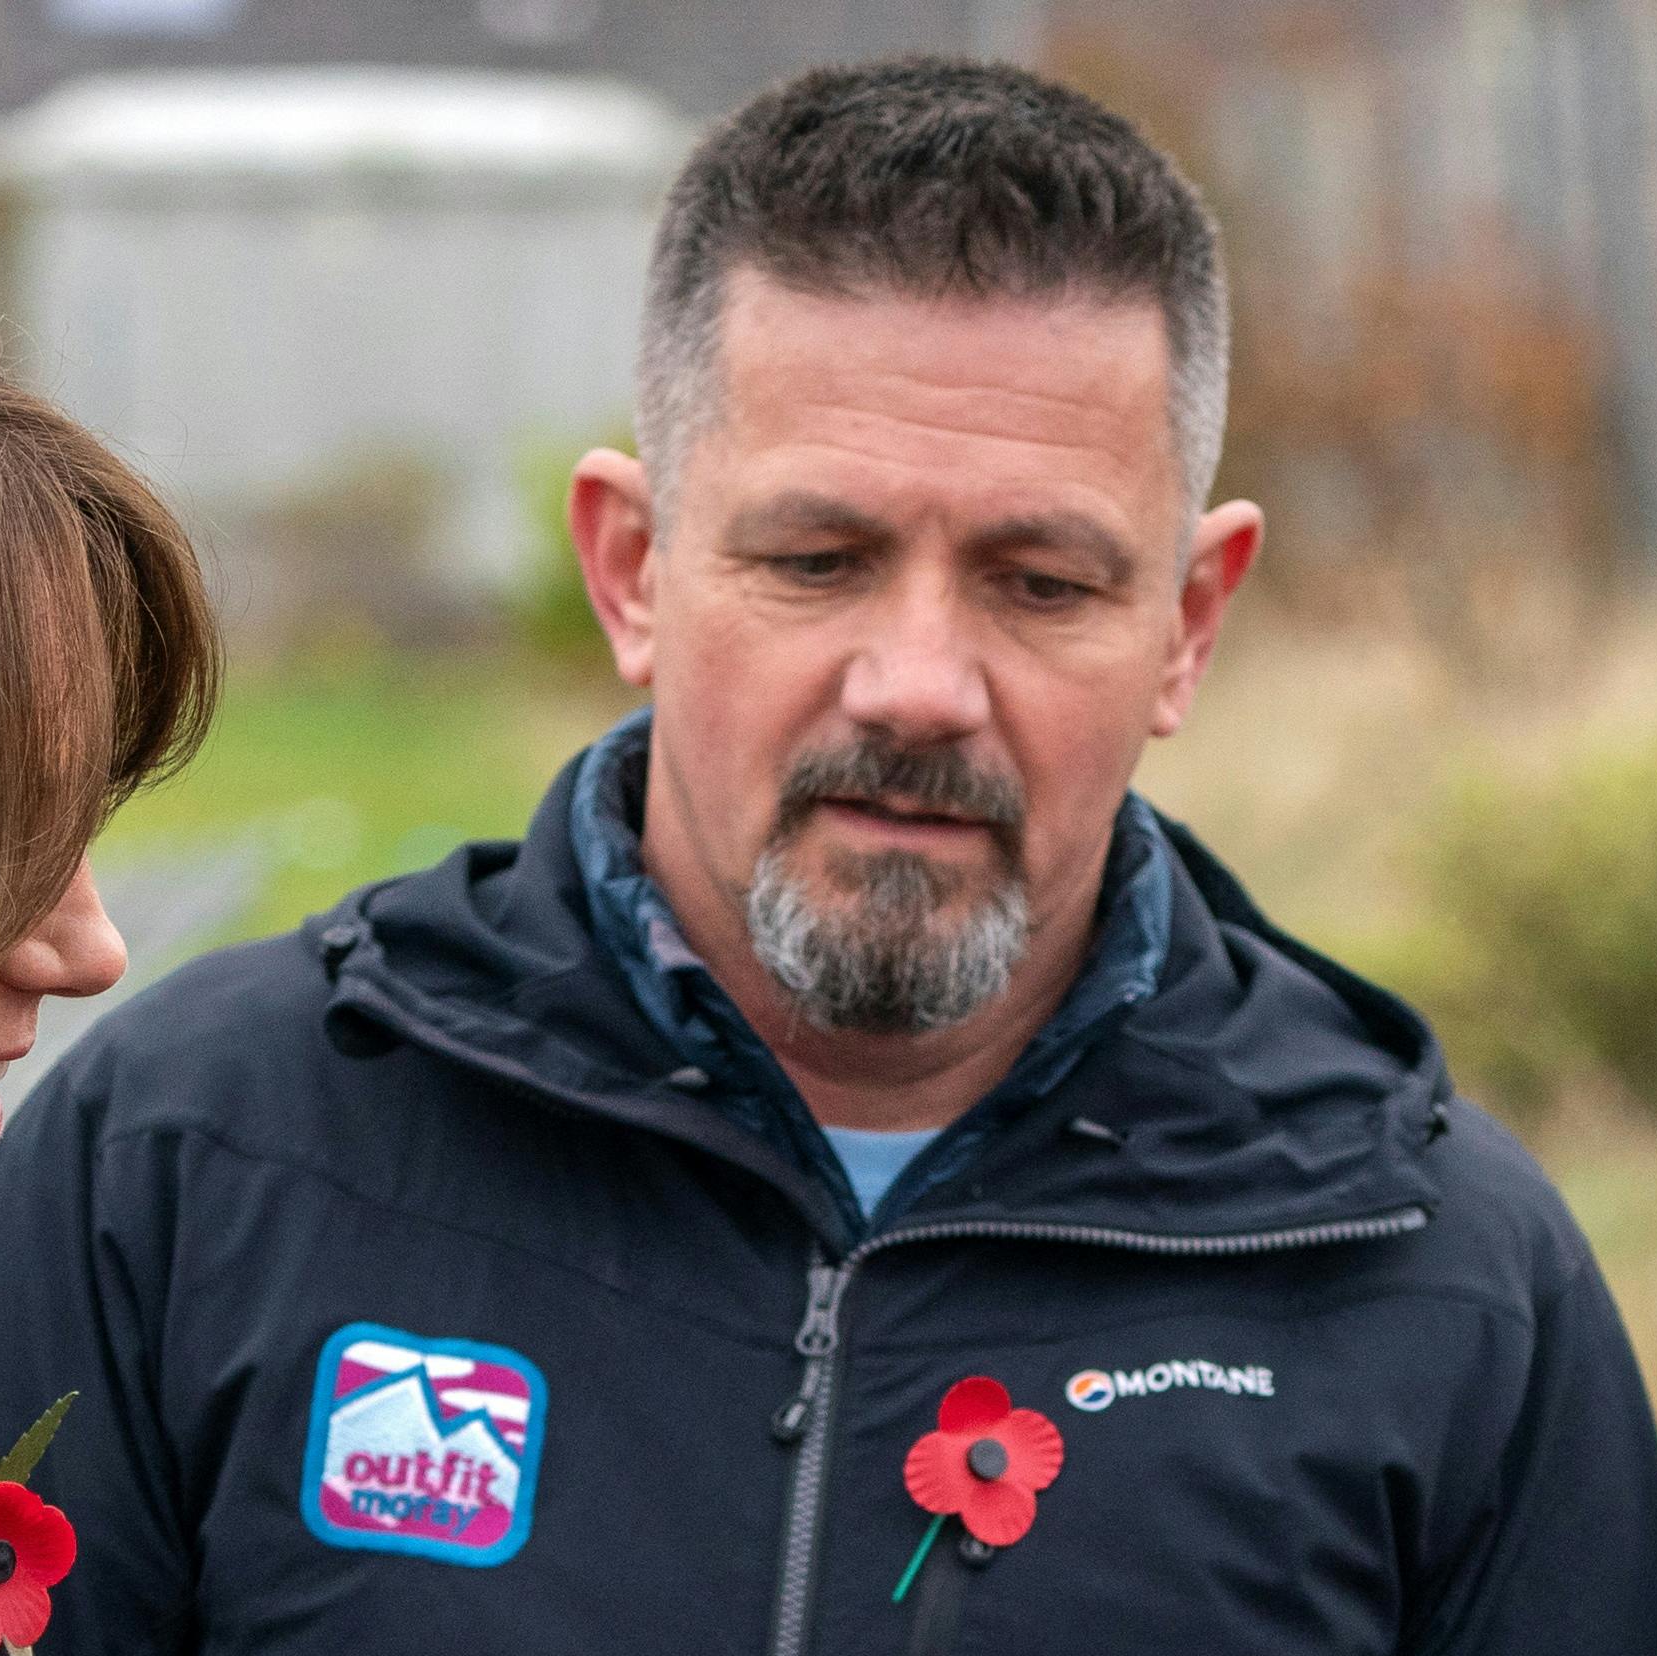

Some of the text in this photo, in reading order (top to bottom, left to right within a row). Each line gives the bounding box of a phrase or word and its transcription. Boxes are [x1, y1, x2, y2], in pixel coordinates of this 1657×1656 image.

[1112, 1358, 1276, 1397] MONTANE
[345, 1450, 497, 1507] outfit
[351, 1489, 480, 1537] moray
